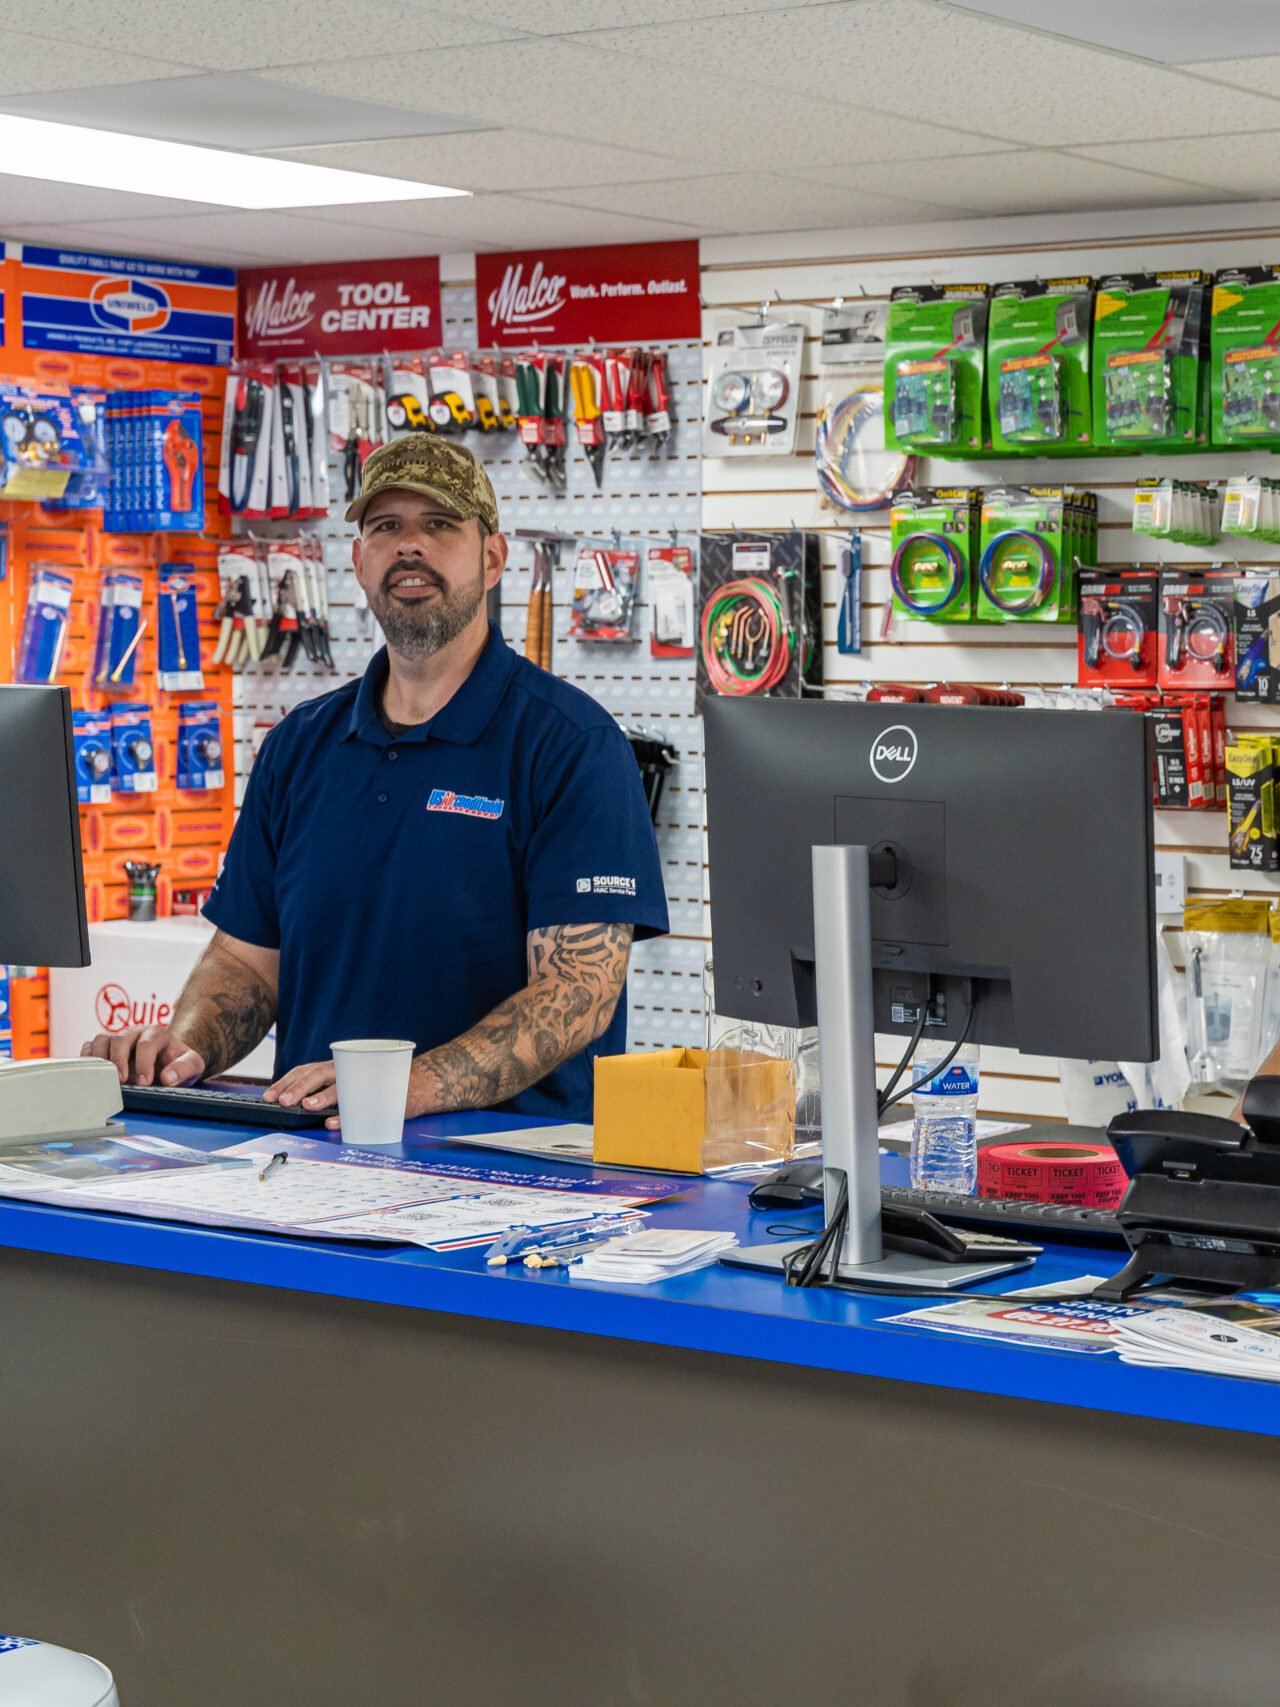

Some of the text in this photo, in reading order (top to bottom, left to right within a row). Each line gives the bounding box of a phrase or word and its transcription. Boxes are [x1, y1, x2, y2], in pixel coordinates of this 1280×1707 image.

[338, 282, 411, 306] TOOL
[488, 261, 566, 326] Malco
[570, 279, 688, 299] Work. Perform. Outlast.
[107, 297, 156, 313] UNIWELD
[245, 277, 316, 340] Malco
[321, 306, 430, 333] CENTER
[1257, 677, 1269, 691] 10
[875, 745, 911, 762] DELL
[1232, 779, 1256, 788] LS/UV
[1249, 847, 1263, 861] 75
[95, 983, 177, 1033] Quie
[943, 1082, 970, 1091] WATER
[1007, 1166, 1038, 1177] TICKET
[1053, 1168, 1084, 1178] TICKET
[1097, 1164, 1121, 1175] TICKET
[1005, 1192, 1039, 1200] KEEP THIS
[1070, 1193, 1086, 1201] THIS
